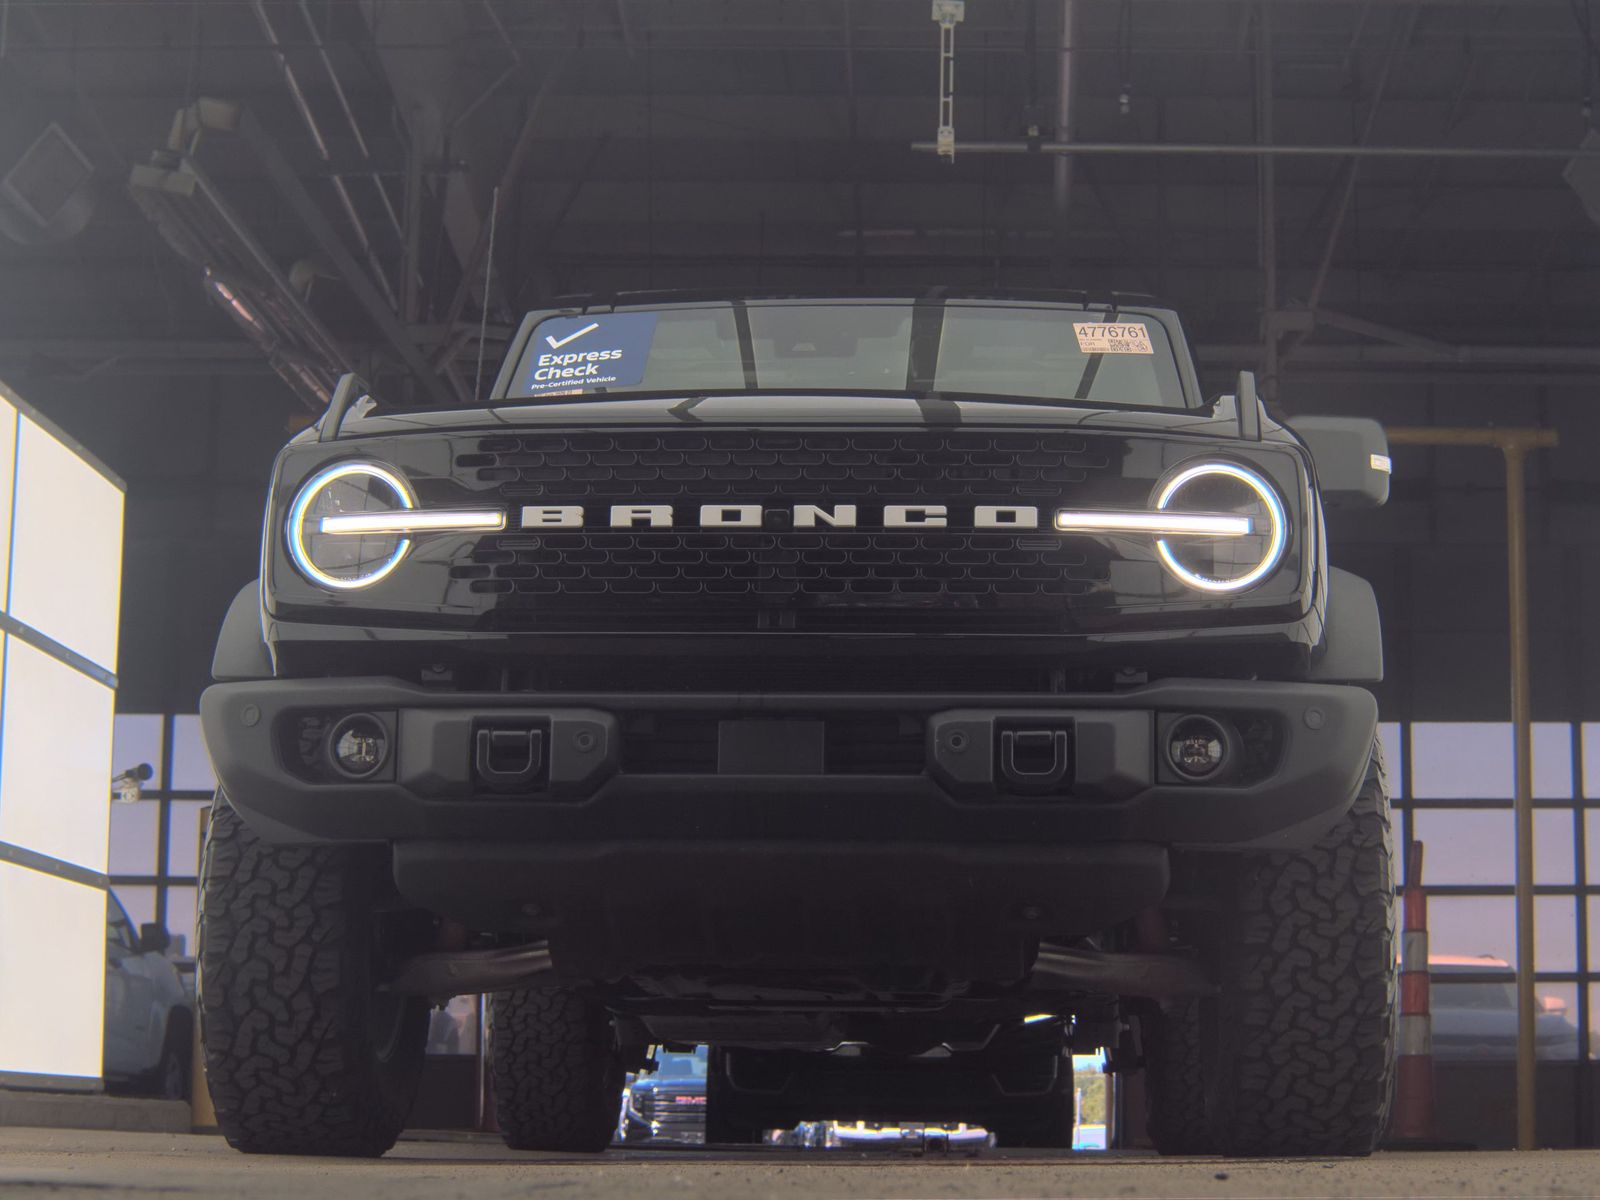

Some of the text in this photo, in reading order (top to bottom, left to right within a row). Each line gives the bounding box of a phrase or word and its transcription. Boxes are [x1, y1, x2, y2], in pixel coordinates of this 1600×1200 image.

[1079, 326, 1146, 338] 4776761
[538, 349, 622, 366] Express
[534, 363, 599, 380] Check
[531, 376, 616, 389] Pre-Certified Vehicle
[521, 504, 1038, 528] BRONCO
